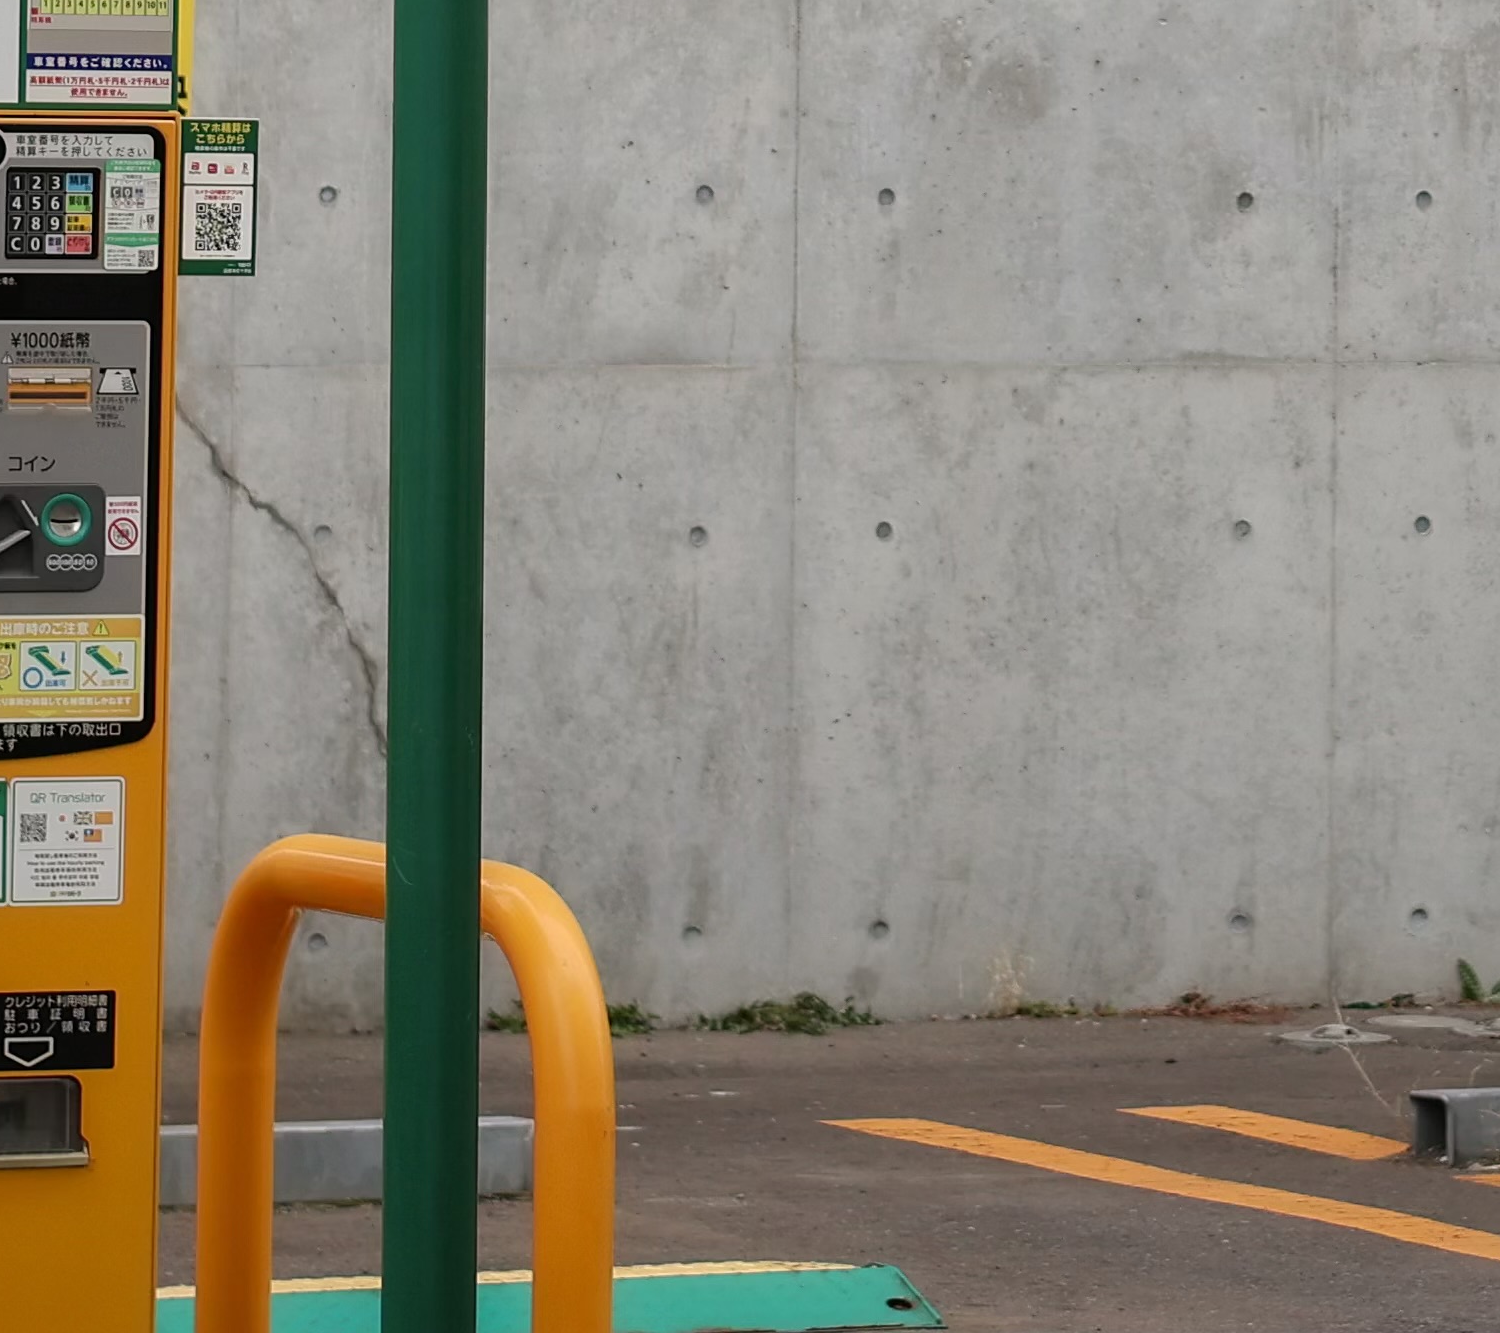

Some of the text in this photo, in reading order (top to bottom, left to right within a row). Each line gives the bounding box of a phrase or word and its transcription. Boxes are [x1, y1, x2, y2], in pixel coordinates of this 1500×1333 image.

[33, 56, 168, 69] 車室番号をご確認ください。
[190, 122, 252, 134] スマホ精算は
[16, 135, 113, 146] 車室番号を入力して
[196, 134, 245, 145] こちらから
[16, 146, 147, 157] 精算キーを押してください
[32, 176, 41, 190] 2
[51, 176, 61, 190] 3
[12, 196, 21, 210] 4
[32, 196, 41, 210] 5
[51, 196, 60, 210] 6
[12, 217, 21, 231] 7
[31, 217, 41, 231] 8
[50, 217, 60, 231] 9
[11, 237, 21, 251] C
[8, 456, 55, 472] コイン
[1, 622, 89, 636] 出庫時のご注意
[30, 792, 106, 804] QR Translator
[4, 995, 108, 1007] クレジット利用明細書
